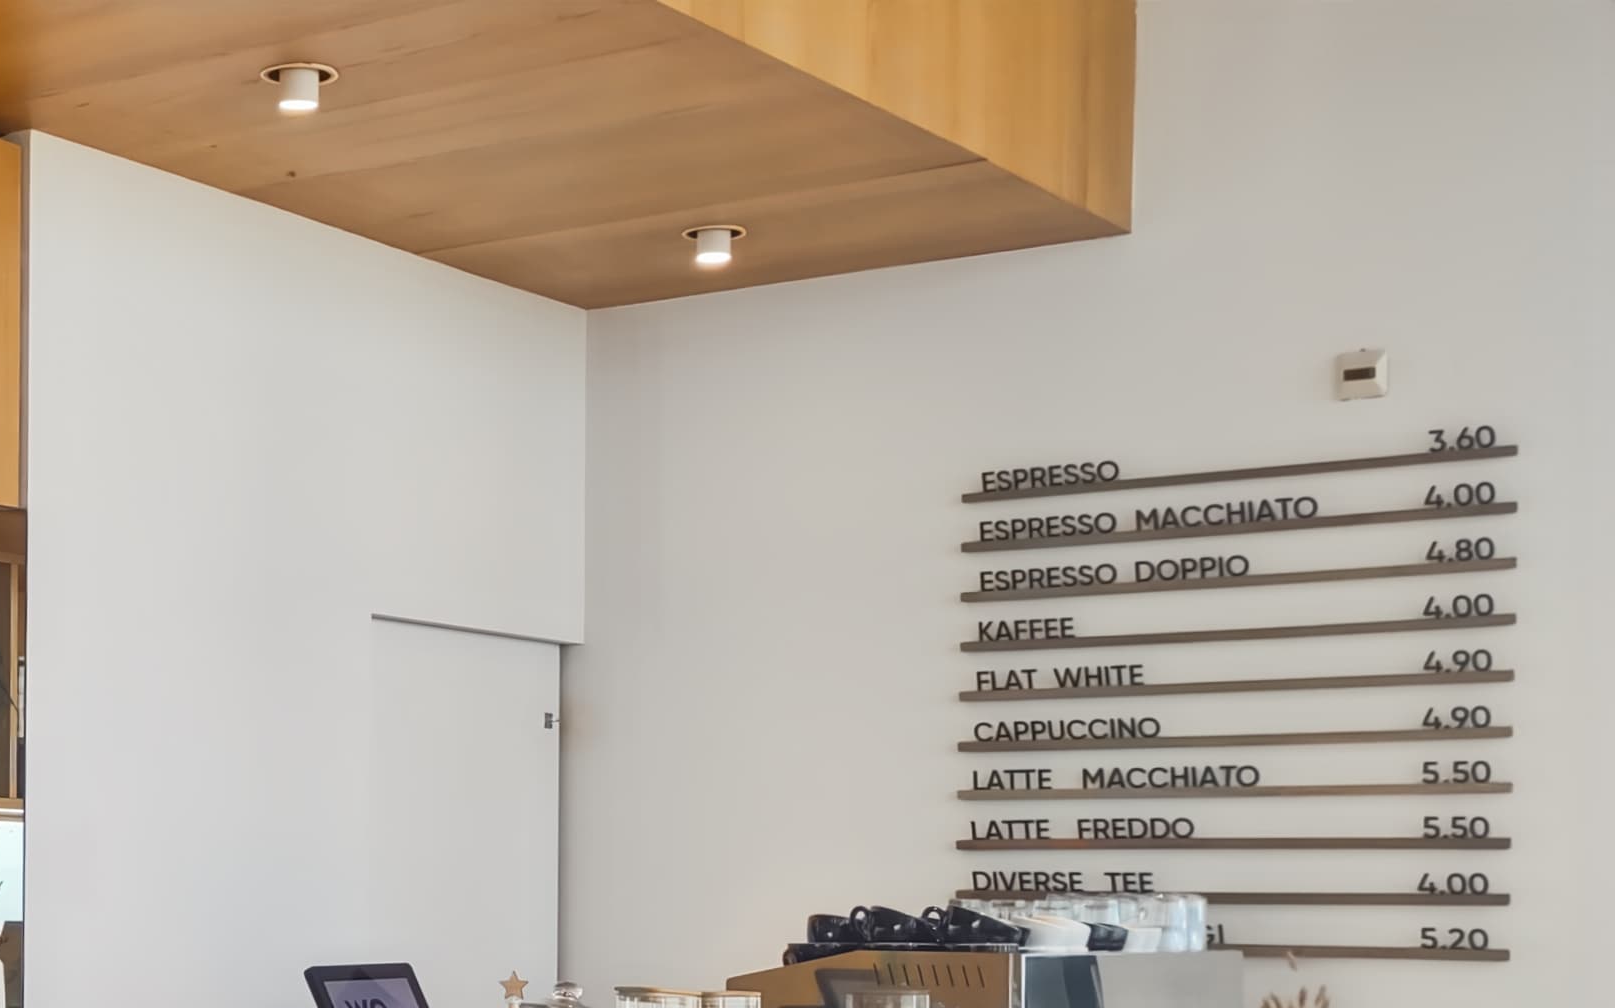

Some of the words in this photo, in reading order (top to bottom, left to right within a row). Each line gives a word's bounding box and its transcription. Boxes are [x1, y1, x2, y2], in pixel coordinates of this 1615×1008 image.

[981, 460, 1120, 493] ESPRESSO
[1428, 425, 1496, 453] 3.60
[979, 512, 1117, 542] ESPRESSO
[1135, 496, 1319, 532] MACCHIATO
[1424, 481, 1496, 508] 4.00
[979, 563, 1117, 592] ESPRESSO
[1135, 554, 1250, 583] DOPPIO
[1425, 537, 1495, 563] 4.80
[978, 617, 1076, 642] KAFFEE
[1423, 593, 1495, 619] 4.00
[976, 668, 1038, 691] FLAT
[1053, 664, 1144, 688] WHITE
[1423, 649, 1493, 674] 4.90
[973, 717, 1161, 742] CAPPUCCINO
[1422, 705, 1492, 731] 4.90
[972, 768, 1053, 790] LATTE
[1082, 765, 1260, 790] MACCHIATO
[1422, 760, 1492, 785] 5.50
[970, 819, 1050, 841] LATTE
[1077, 817, 1195, 840] FREDDO
[1422, 816, 1490, 840] 5.50
[972, 871, 1084, 893] DIVERSE
[1104, 872, 1154, 893] TEE
[1417, 872, 1489, 897] 4.00
[1420, 927, 1489, 952] 5.20
